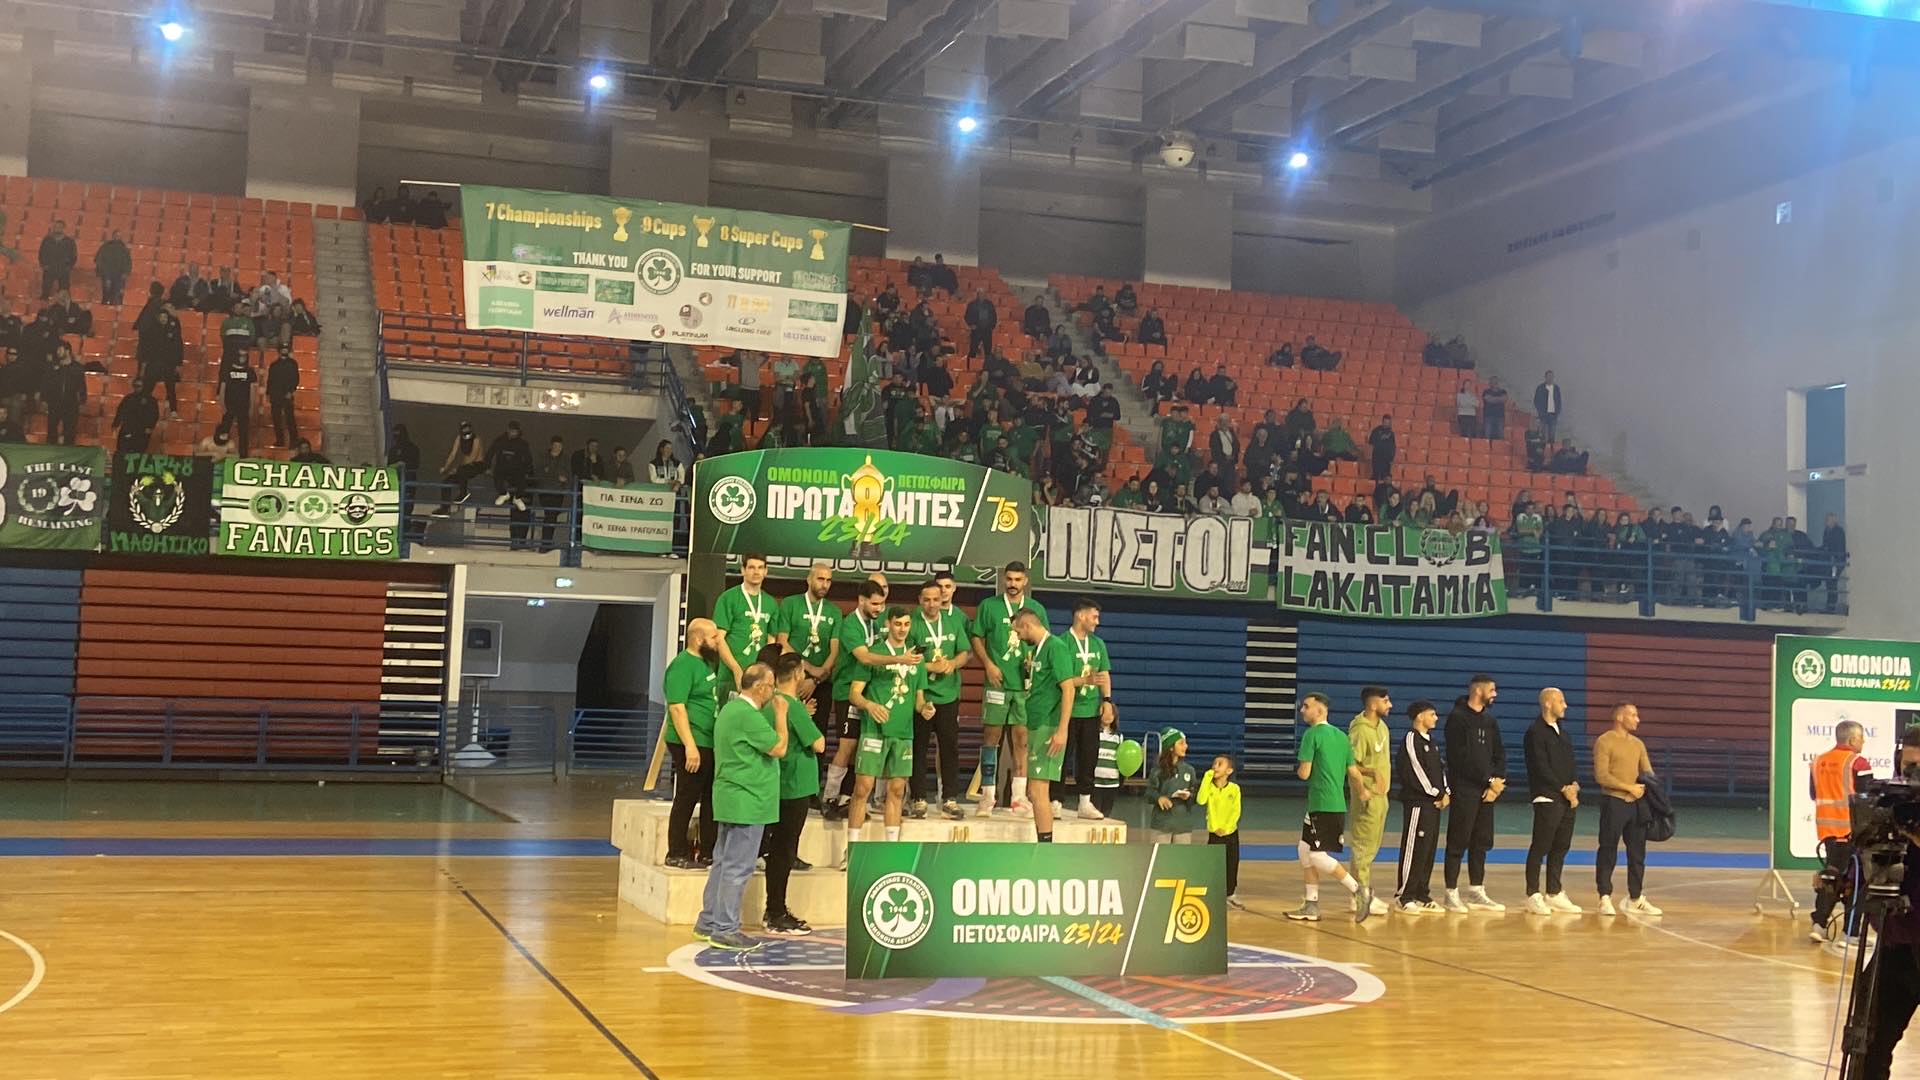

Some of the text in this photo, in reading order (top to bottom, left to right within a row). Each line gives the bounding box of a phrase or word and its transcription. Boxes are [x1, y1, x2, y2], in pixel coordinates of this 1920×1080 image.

[485, 202, 602, 232] 7 Championships
[653, 218, 687, 241] Cups
[730, 226, 769, 248] Super
[771, 230, 804, 253] Cups
[573, 252, 606, 268] THANK
[608, 255, 628, 269] YOU
[691, 262, 711, 277] FOR
[712, 264, 738, 279] YOUR
[738, 266, 783, 284] SUPPORT
[543, 305, 595, 320] wellman
[24, 463, 52, 474] THE
[233, 462, 391, 491] CHANIA
[767, 466, 838, 484] ΟΜΟΝΟΙΑ
[32, 488, 47, 498] 19
[898, 475, 966, 491] ΠΕΤΟΣΦΑΙΡΑ
[18, 516, 93, 529] REMAINING
[986, 496, 1019, 533] 75
[226, 523, 393, 556] FANATICS
[818, 512, 911, 552] 23/24
[1045, 506, 1253, 592] ΠΙΣΤΟΙ
[1283, 566, 1496, 615] LAKATAMIA
[1830, 653, 1912, 676] ΟΜΟΝΟΙΑ
[952, 878, 1124, 917] ΟΜΟΝΟΙΑ
[1154, 878, 1212, 944] 75
[952, 918, 1124, 949] ΠΕΤΟΣΦΑΙΡΑ 23/24
